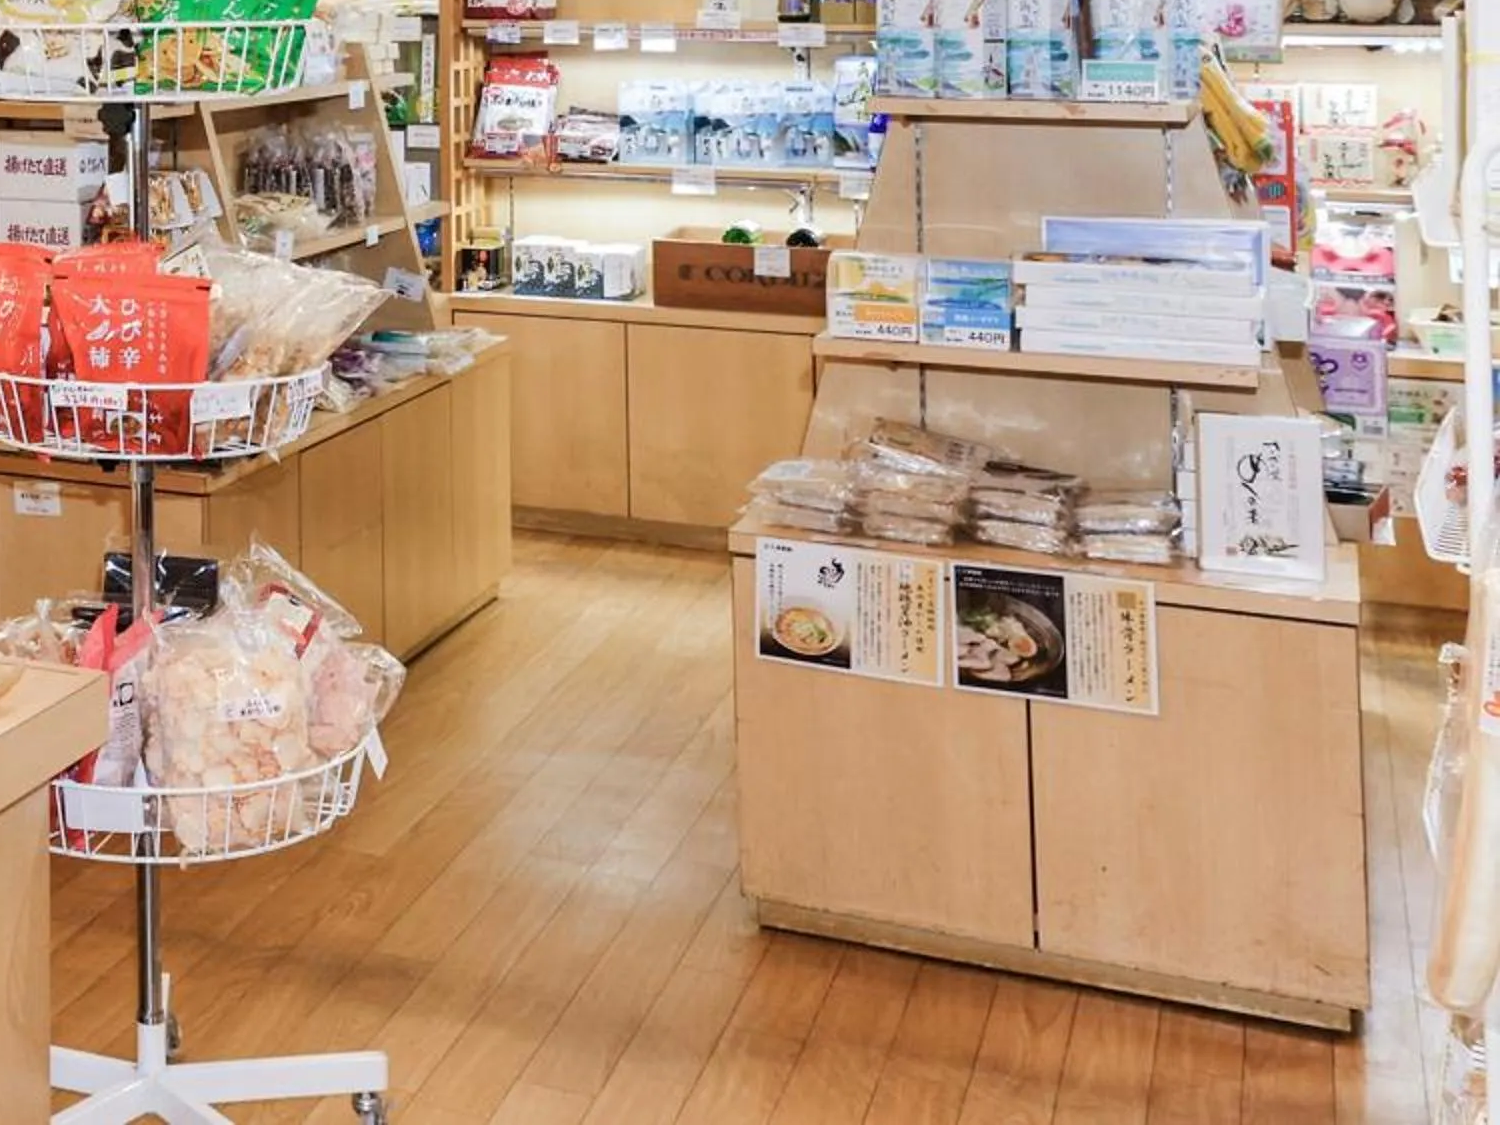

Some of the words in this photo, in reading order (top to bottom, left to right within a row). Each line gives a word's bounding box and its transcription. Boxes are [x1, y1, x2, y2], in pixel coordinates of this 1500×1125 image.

[4, 154, 68, 177] 揚げたて直送
